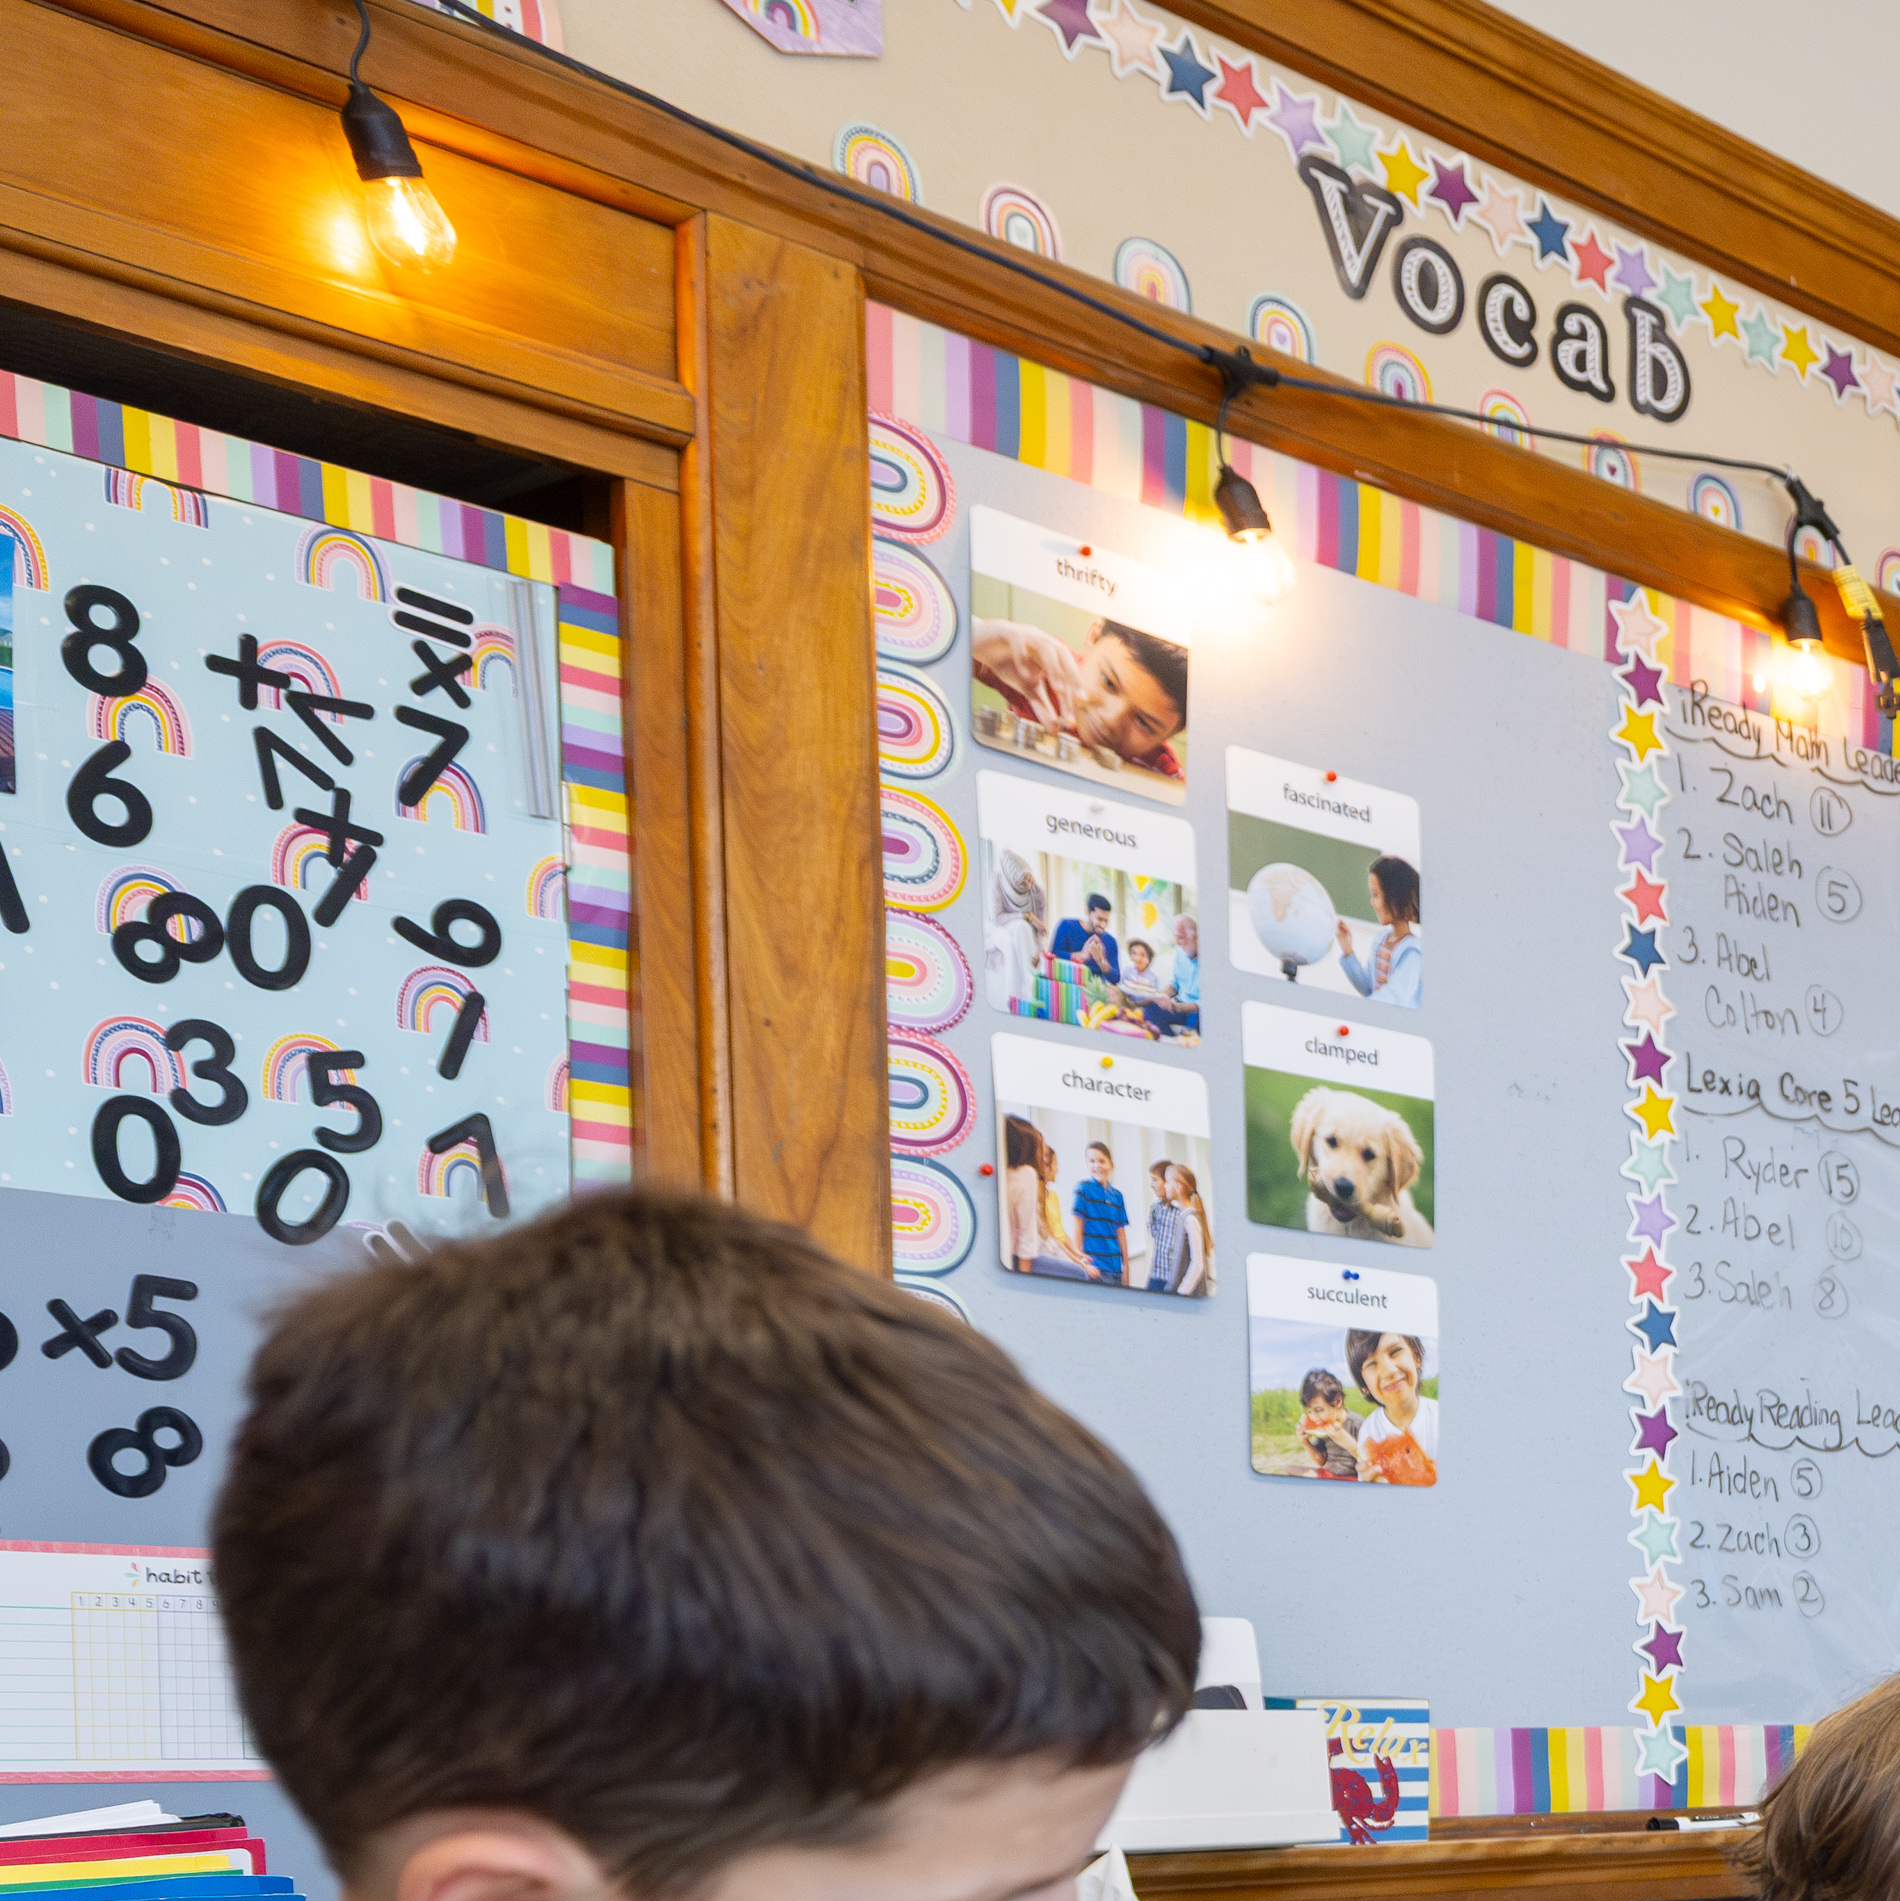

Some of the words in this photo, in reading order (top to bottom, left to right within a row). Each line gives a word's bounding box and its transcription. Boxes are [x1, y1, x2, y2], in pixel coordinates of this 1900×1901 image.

[1297, 154, 1692, 423] Vocab
[1055, 556, 1117, 595] thrifty
[60, 584, 148, 697] 8
[66, 740, 153, 848] 6
[1283, 784, 1371, 824] fascinated
[1709, 767, 1794, 825] Zach
[1045, 813, 1137, 849] generous
[1723, 875, 1801, 928] Aiden
[1705, 985, 1800, 1035] Colton
[165, 1018, 249, 1126] 3
[1304, 1037, 1379, 1066] clamped
[307, 1050, 383, 1153] 5
[1062, 1069, 1151, 1103] character
[1686, 1052, 1761, 1099] Lexia
[1779, 1072, 1832, 1110] Core
[1842, 1079, 1861, 1115] 5
[1722, 1136, 1809, 1195] Ryder
[1721, 1197, 1796, 1250] Abel
[1307, 1284, 1388, 1310] succulent
[1757, 1388, 1843, 1450] Reading
[1708, 1451, 1779, 1502] Aiden
[1716, 1522, 1782, 1558] Zach
[146, 1566, 203, 1584] habit
[1723, 1575, 1784, 1611] Sam
[1317, 1701, 1430, 1769] Relax
